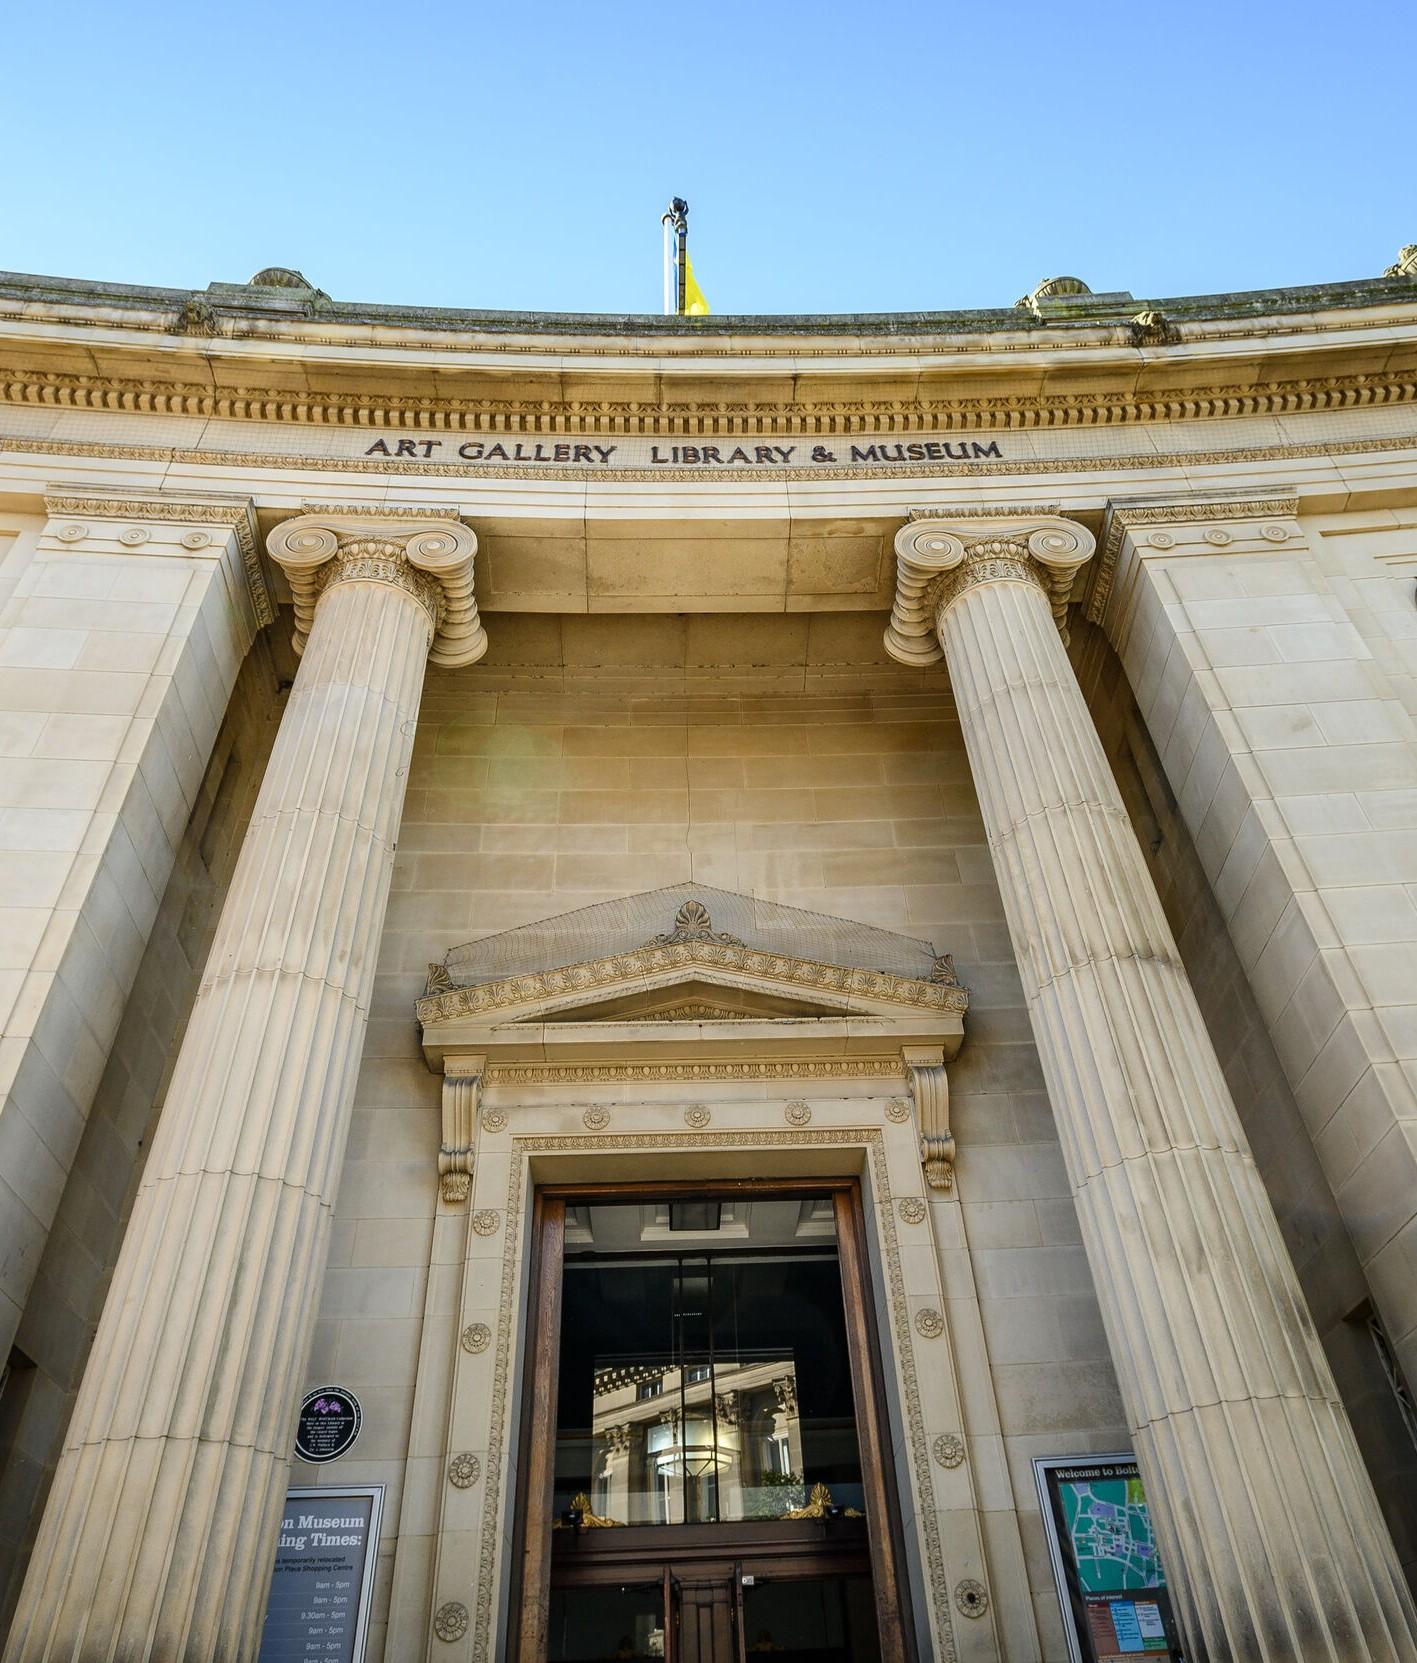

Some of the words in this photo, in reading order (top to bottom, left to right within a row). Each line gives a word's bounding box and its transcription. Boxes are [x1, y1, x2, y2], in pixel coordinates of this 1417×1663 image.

[365, 438, 442, 458] ART
[458, 442, 617, 463] GALLERY
[650, 445, 797, 464] LIBRARY
[811, 445, 837, 463] &
[850, 441, 1003, 463] MUSEUM
[1056, 1469, 1100, 1479] Welcome
[1102, 1467, 1114, 1476] to
[297, 1515, 364, 1529] Museum
[311, 1533, 362, 1546] Times:
[336, 1581, 351, 1590] 5pm
[313, 1596, 328, 1604] 9am
[333, 1596, 348, 1604] 5pm
[301, 1611, 326, 1619] 9.30am
[331, 1611, 346, 1619] 5pm
[328, 1626, 344, 1635] 5pm
[306, 1642, 321, 1650] 9am
[326, 1642, 341, 1651] 5pm
